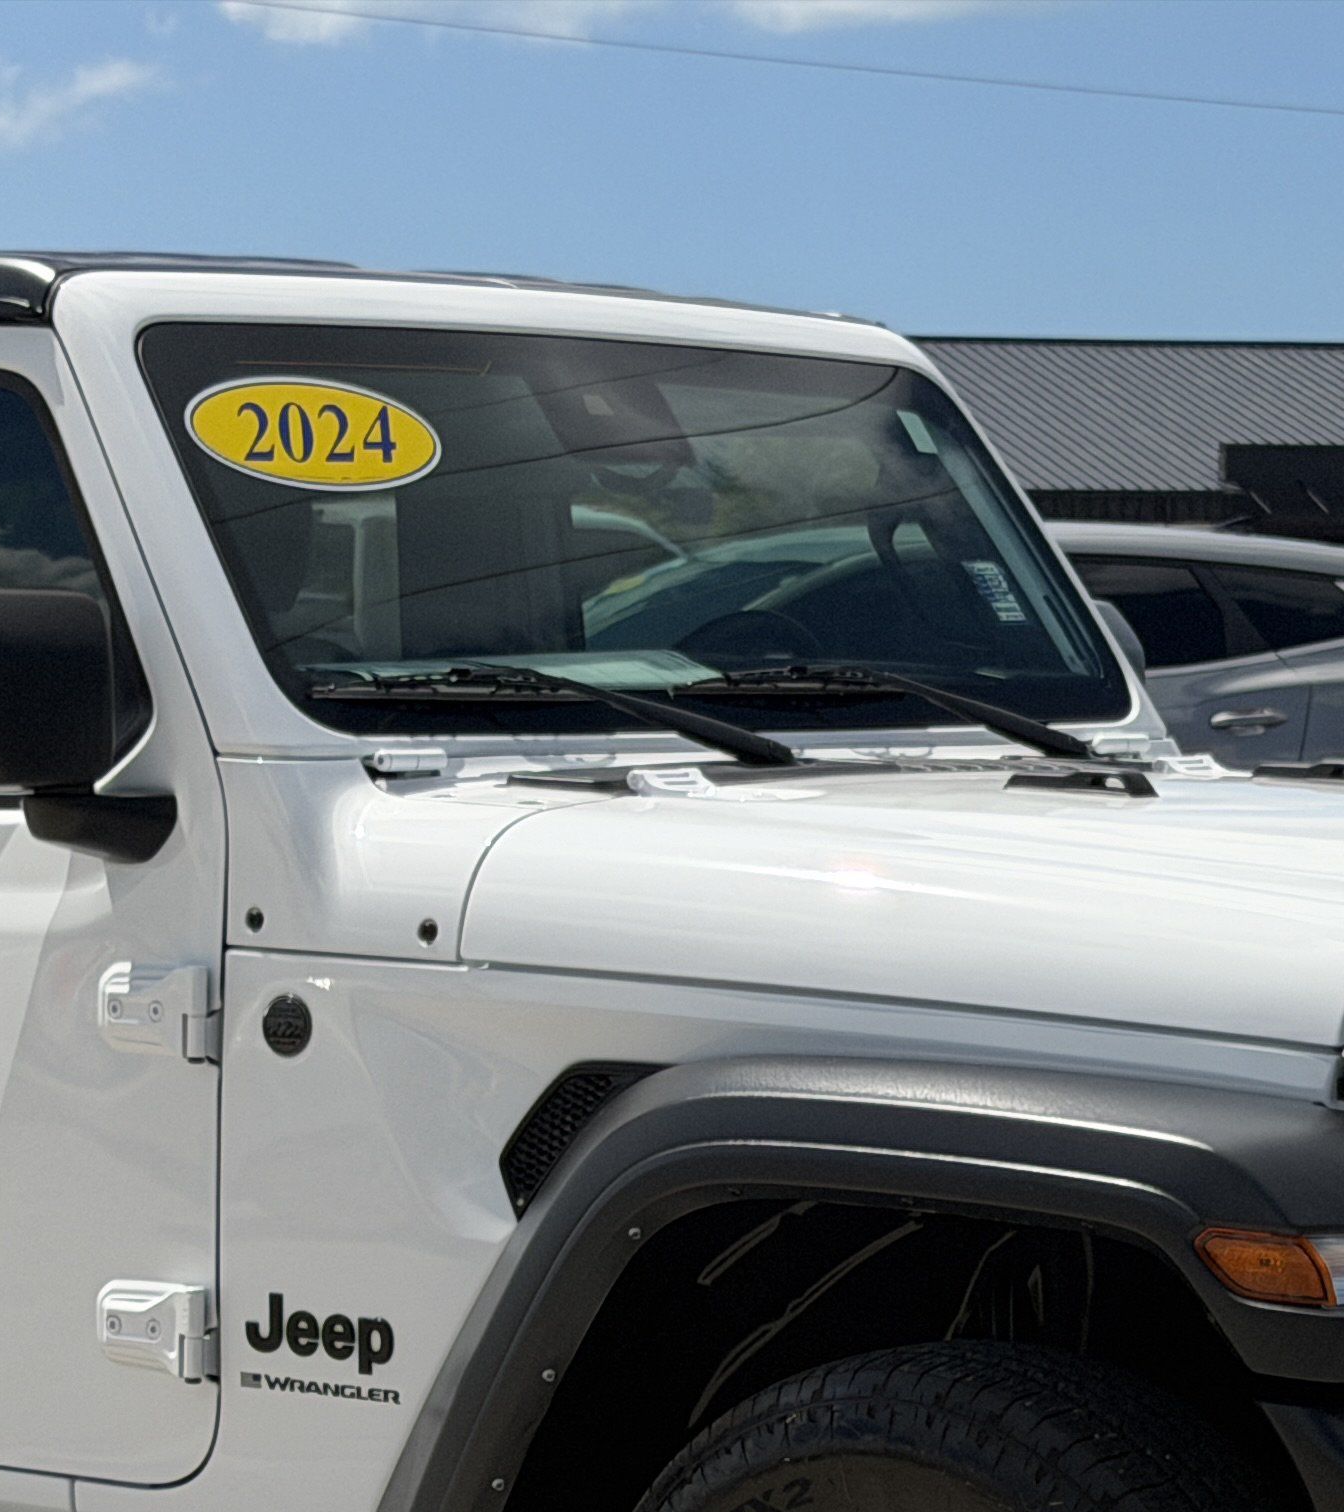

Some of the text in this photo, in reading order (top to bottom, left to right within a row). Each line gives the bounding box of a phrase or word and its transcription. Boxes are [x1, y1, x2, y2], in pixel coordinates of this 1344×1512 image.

[237, 402, 397, 464] 2024
[245, 1292, 395, 1375] Jeep
[264, 1374, 401, 1405] WRANGLER
